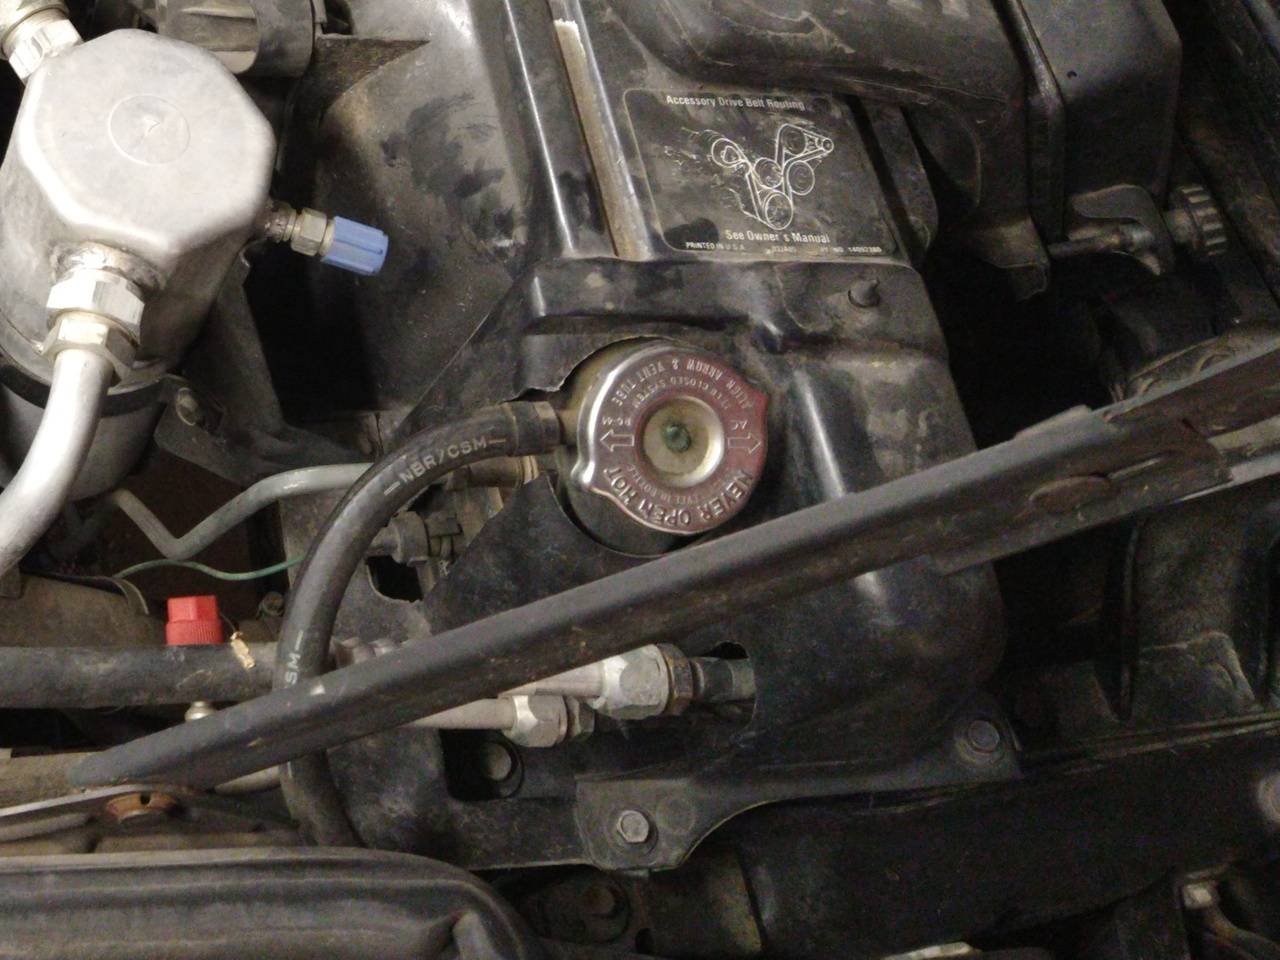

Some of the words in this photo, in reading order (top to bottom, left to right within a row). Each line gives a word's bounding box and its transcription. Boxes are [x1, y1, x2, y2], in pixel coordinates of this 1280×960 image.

[666, 95, 716, 108] Accessory
[718, 96, 744, 107] Drive
[745, 97, 765, 108] Belt
[767, 98, 805, 111] Routing
[725, 229, 744, 241] See
[746, 230, 790, 242] Owners
[791, 232, 830, 244] Manual
[635, 360, 666, 383] VENT
[686, 358, 723, 381] ARROW
[611, 378, 637, 407] TUBE
[602, 467, 638, 506] HOT
[696, 468, 755, 523] NEVER
[638, 498, 692, 528] OPEN
